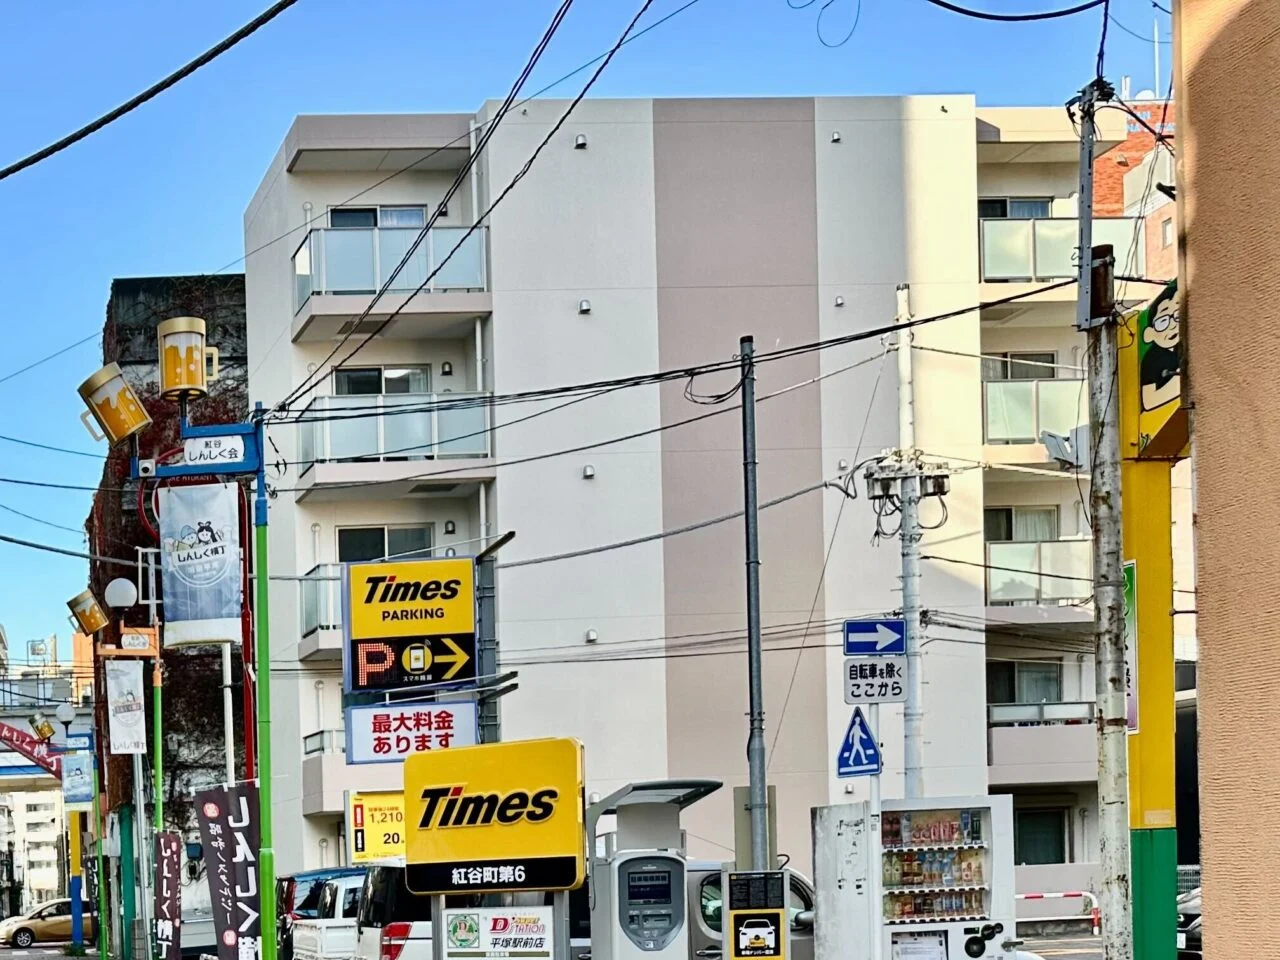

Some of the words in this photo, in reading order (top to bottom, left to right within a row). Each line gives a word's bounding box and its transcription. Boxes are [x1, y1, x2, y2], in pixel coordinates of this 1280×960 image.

[188, 447, 239, 462] しんしく会
[177, 544, 227, 563] しんしく横丁
[364, 575, 461, 605] Times
[381, 607, 445, 622] PARKING
[358, 642, 395, 686] P
[849, 662, 902, 680] 自転車を除く
[850, 681, 902, 698] ここから
[372, 710, 454, 733] 最大料金
[373, 732, 454, 754] あります
[419, 786, 558, 828] Times
[370, 811, 403, 824] 1,210
[383, 832, 400, 845] 20
[452, 865, 526, 885] 紅谷町第6
[490, 937, 546, 949] 平塚駅前店
